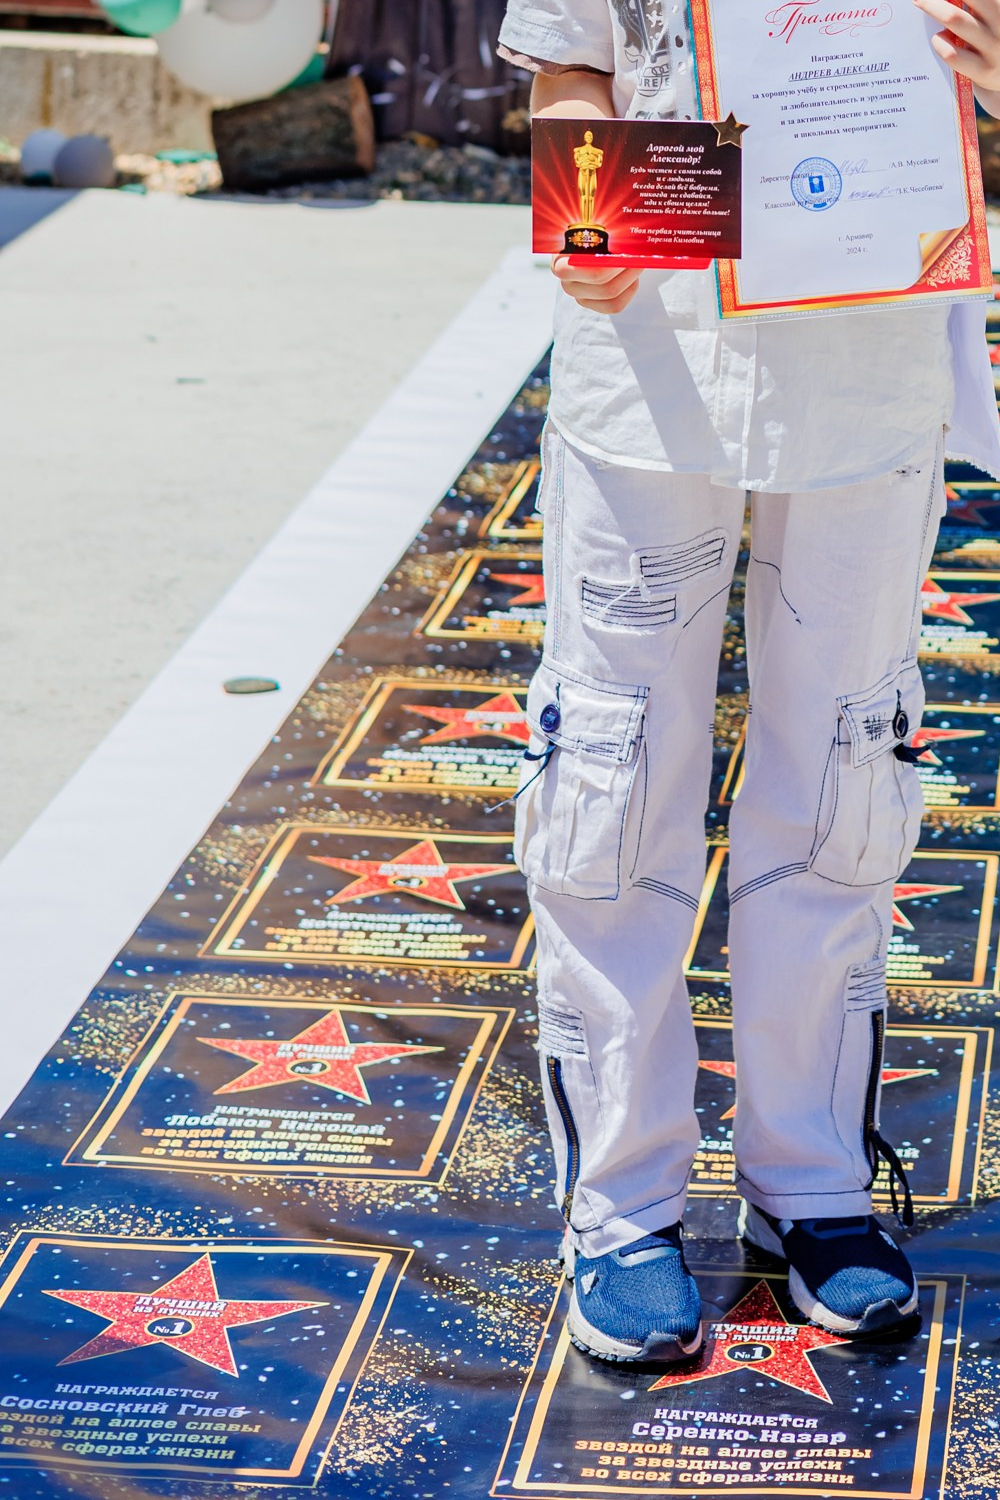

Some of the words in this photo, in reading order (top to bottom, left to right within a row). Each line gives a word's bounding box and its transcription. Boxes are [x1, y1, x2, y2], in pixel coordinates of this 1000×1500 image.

[811, 51, 864, 63] Награждается
[789, 68, 832, 82] АНДРЕЕВ
[834, 62, 890, 77] АЛЕКСАНДР
[761, 89, 796, 99] хорошую
[797, 86, 818, 96] учёбу
[826, 80, 869, 92] стремление
[871, 78, 901, 88] учиться
[789, 97, 858, 110] любознательность
[867, 92, 904, 102] эрудицию
[797, 114, 832, 124] активное
[832, 111, 862, 122] участие
[870, 106, 907, 116] классных
[800, 128, 841, 138] школьных
[842, 122, 898, 134] мероприятиях.
[646, 143, 685, 154] Дорогой
[686, 145, 705, 153] мой
[650, 154, 701, 166] Александр!
[630, 165, 646, 174] Будь
[632, 182, 655, 190] всегда
[677, 183, 689, 191] всё
[663, 199, 685, 207] своим
[685, 200, 710, 208] целям!
[664, 207, 677, 215] всё
[702, 208, 731, 216] больше!
[629, 226, 647, 234] Твоя
[647, 227, 672, 236] первая
[672, 229, 722, 238] учительница
[646, 236, 672, 244] Зарема
[673, 236, 705, 244] Кимовна
[213, 1104, 355, 1122] НАГРАЖДАЕТСЯ
[141, 1128, 226, 1141] звездой
[231, 1130, 254, 1139] на
[261, 1132, 322, 1142] аллее
[327, 1133, 394, 1147] славы
[158, 1139, 183, 1149] за
[188, 1139, 289, 1152] звездные
[294, 1141, 367, 1155] успехи
[141, 1147, 167, 1156] во
[171, 1148, 219, 1160] всех
[223, 1147, 299, 1164] сферах
[304, 1152, 374, 1165] жизни
[136, 1295, 228, 1311] ЛУЧШИЙ
[132, 1305, 160, 1316] из
[159, 1307, 222, 1319] лучших
[152, 1320, 187, 1336] №1
[708, 1331, 729, 1341] из
[731, 1332, 797, 1342] лучших
[710, 1322, 799, 1337] ЛУЧШИЙ
[734, 1345, 766, 1361] №1
[55, 1383, 220, 1401] НАГРАЖДАЕТСЯ
[0, 1395, 170, 1416] Сосновский
[177, 1403, 245, 1419] Глеб
[71, 1416, 101, 1428] на
[108, 1419, 178, 1430] аллее
[185, 1421, 262, 1434] славы
[654, 1407, 819, 1429] НАГРАЖДАЕТСЯ
[21, 1426, 139, 1442] звездные
[146, 1433, 229, 1446] успехи
[632, 1421, 751, 1443] Серенко
[759, 1429, 847, 1447] Назар
[1, 1436, 56, 1450] всех
[61, 1441, 150, 1457] сферах
[154, 1446, 236, 1460] жизни
[575, 1439, 675, 1457] звездой
[681, 1445, 709, 1457] на
[717, 1448, 789, 1460] аллее
[795, 1448, 872, 1460] славы
[598, 1456, 626, 1467] за
[633, 1457, 752, 1472] звездные
[759, 1460, 843, 1474] успехи
[580, 1468, 609, 1479] во
[617, 1470, 671, 1483] всех
[678, 1471, 767, 1487] сферах
[774, 1472, 855, 1485] жизни
